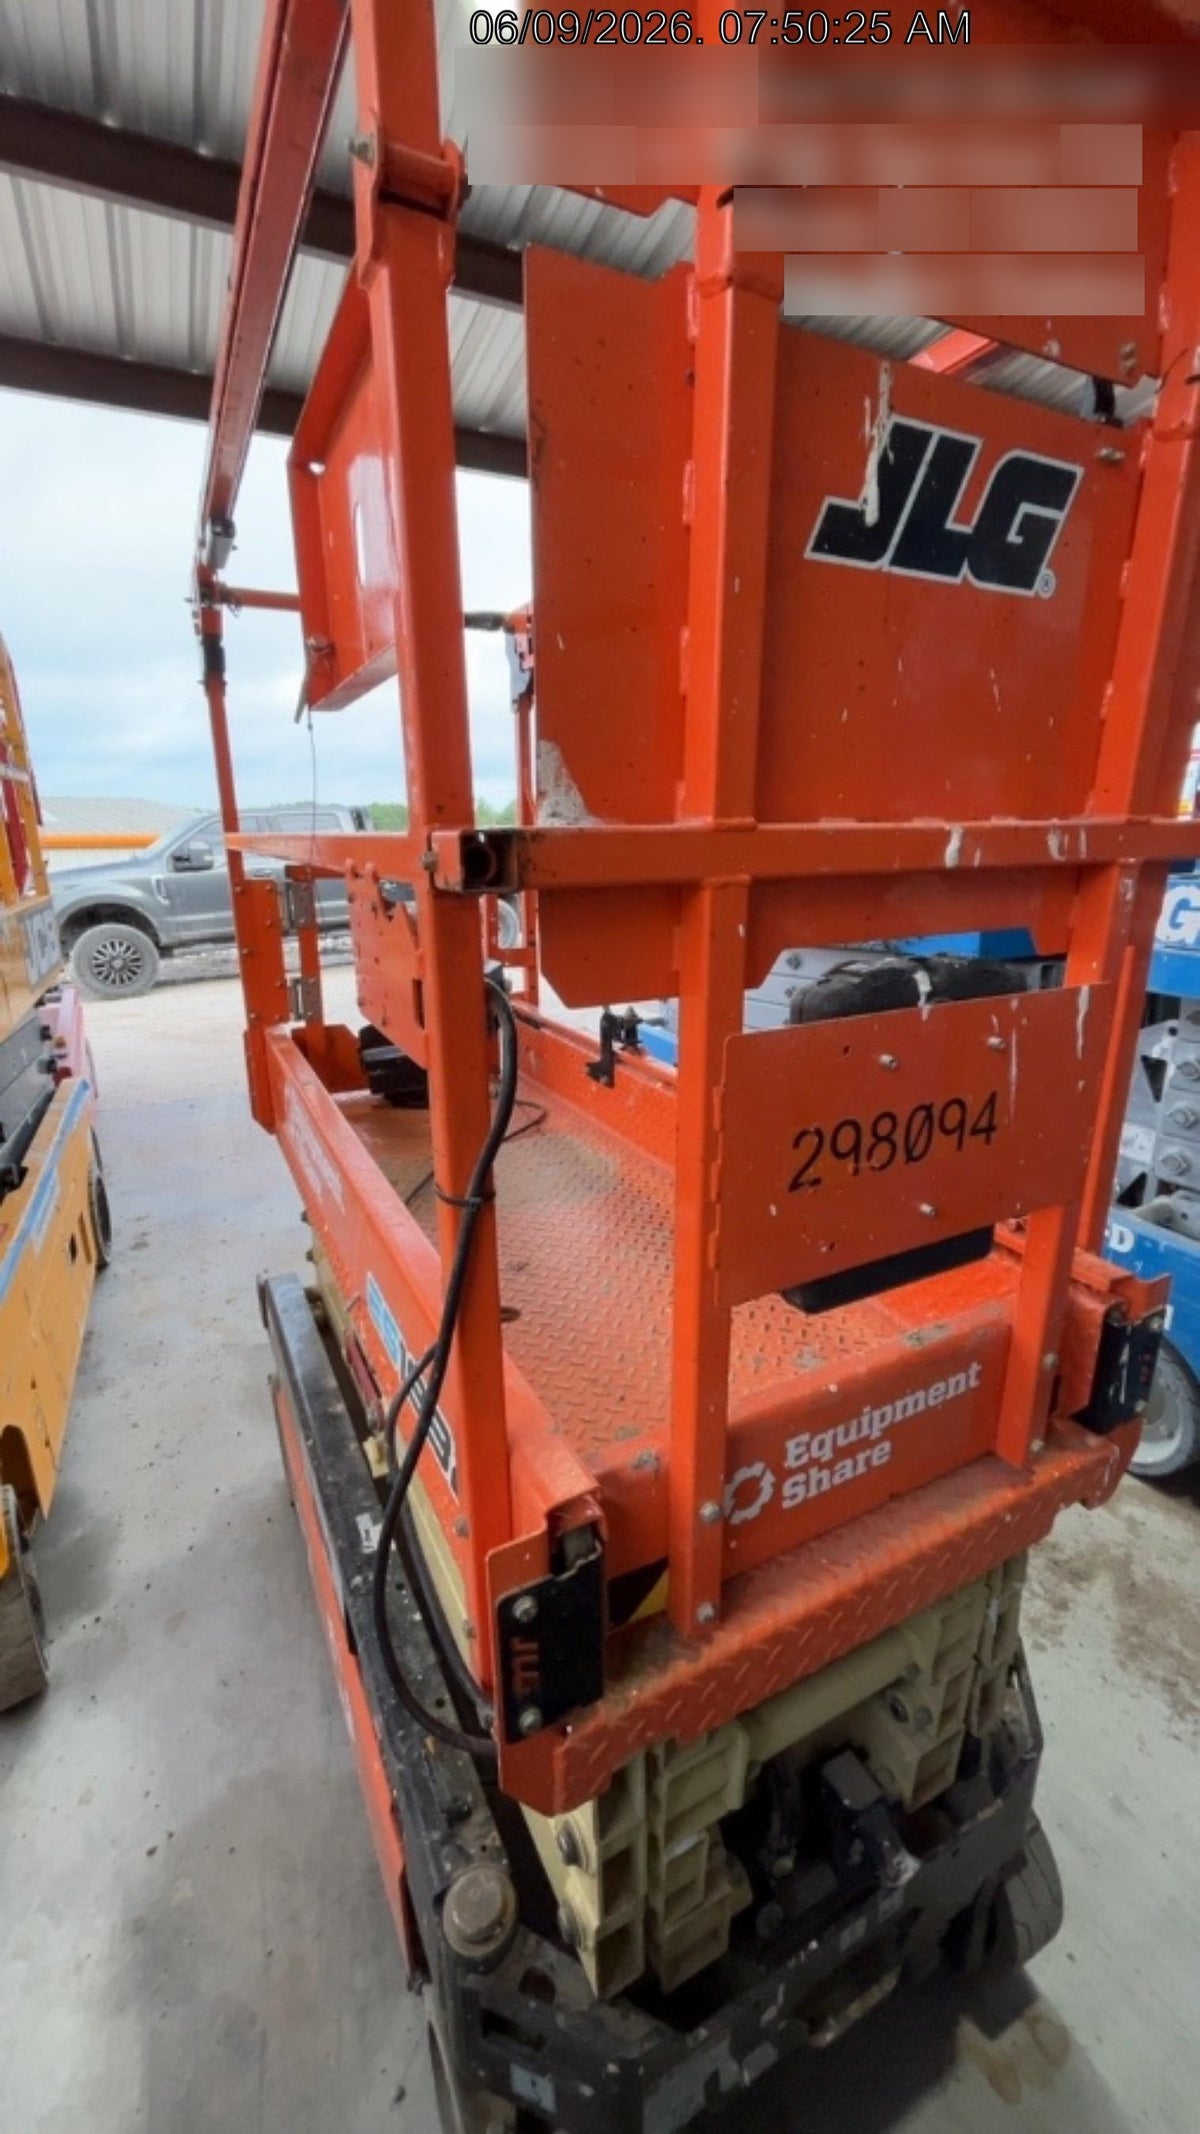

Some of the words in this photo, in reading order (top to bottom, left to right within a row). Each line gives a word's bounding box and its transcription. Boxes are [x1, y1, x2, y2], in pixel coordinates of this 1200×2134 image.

[804, 414, 1084, 596] JLG
[788, 1091, 998, 1193] 298094
[785, 1361, 981, 1469] Equipment
[782, 1441, 892, 1509] Share
